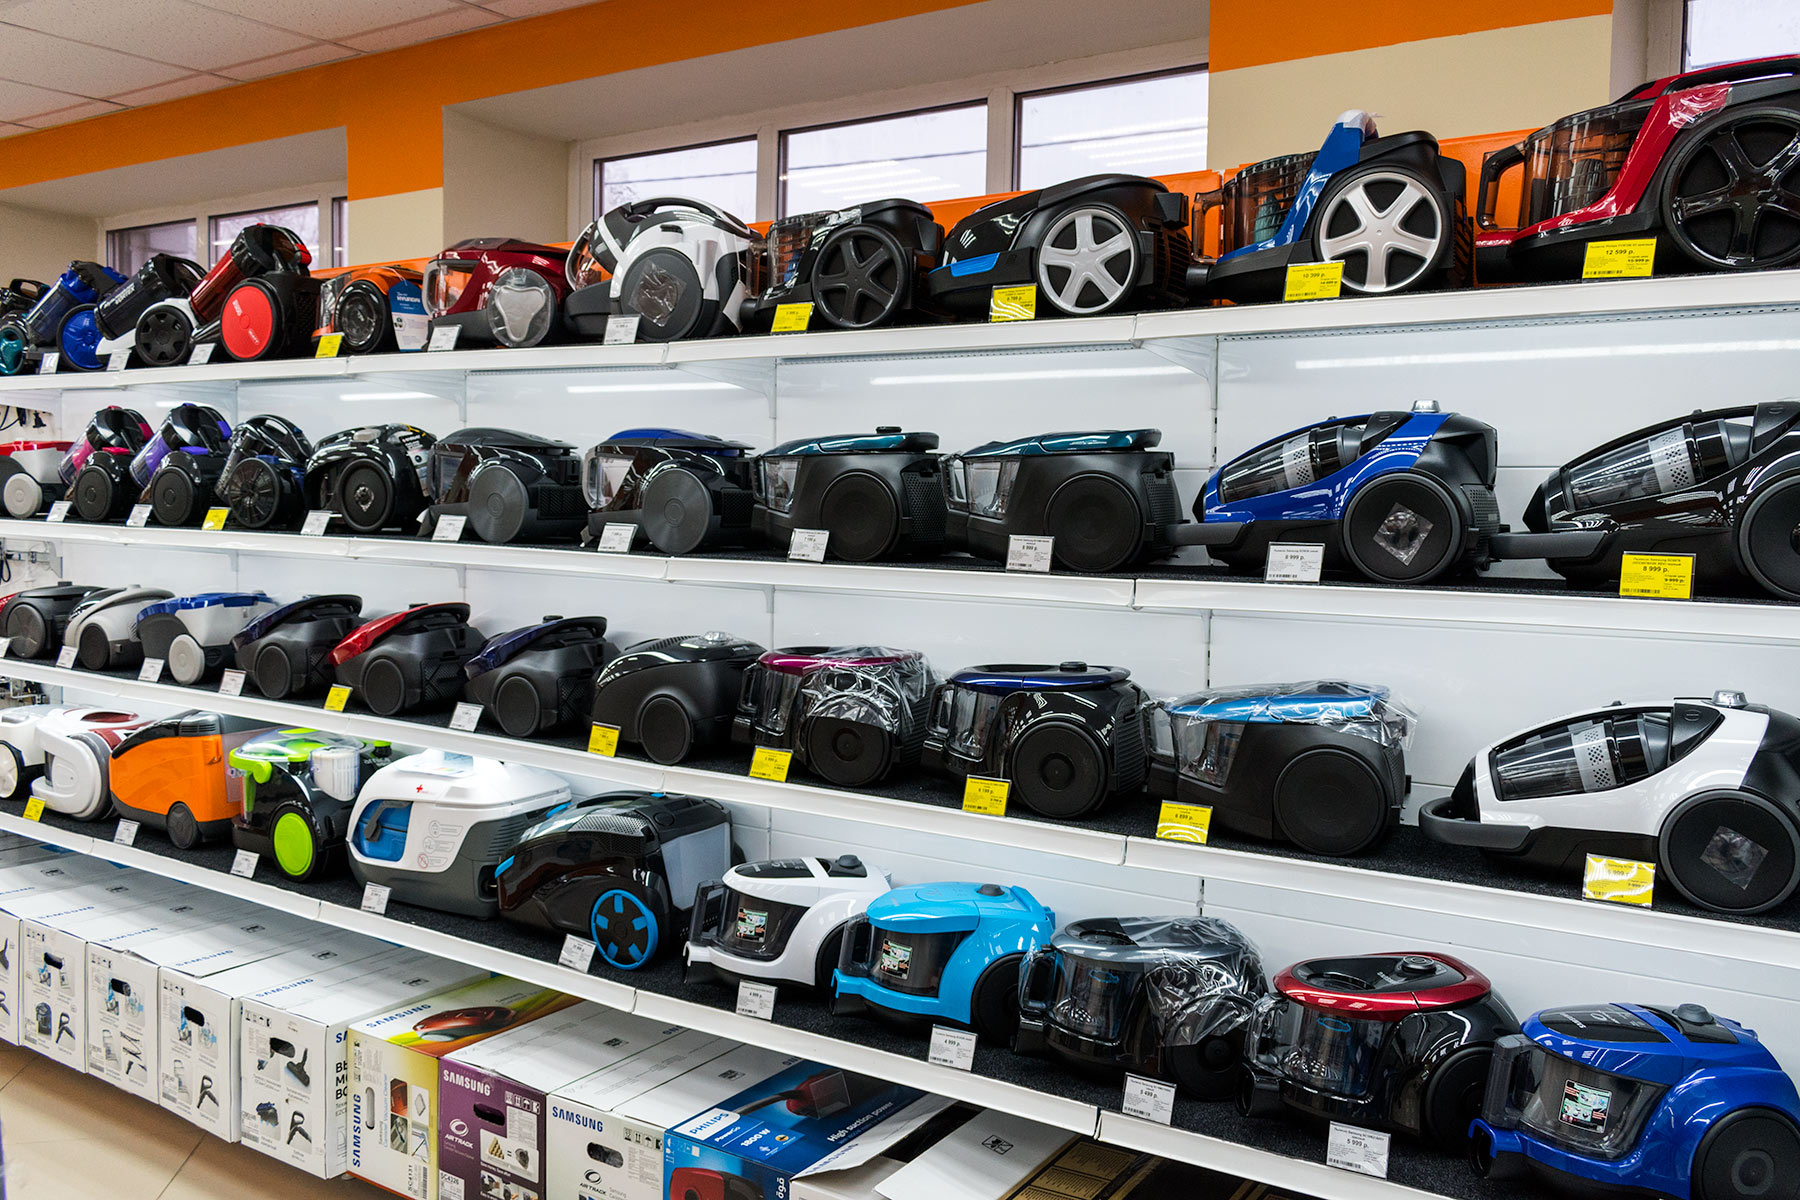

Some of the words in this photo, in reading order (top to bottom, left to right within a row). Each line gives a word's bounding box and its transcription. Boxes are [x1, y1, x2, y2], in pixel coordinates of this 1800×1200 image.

[38, 906, 94, 919] SAMSUNG
[101, 927, 158, 942] SAMSUNG
[176, 950, 234, 967] SAMSUNG
[256, 978, 314, 998] SAMSUNG
[366, 1004, 432, 1028] SAMSUNG
[443, 1069, 491, 1096] SAMSUNG
[552, 1106, 604, 1132] SAMSUNG
[690, 1113, 729, 1134] PHILIPS
[827, 1130, 848, 1142] High
[847, 1114, 874, 1131] suction
[872, 1102, 893, 1116] power
[352, 1094, 361, 1168] SAMSUNG
[741, 1134, 762, 1146] 1800
